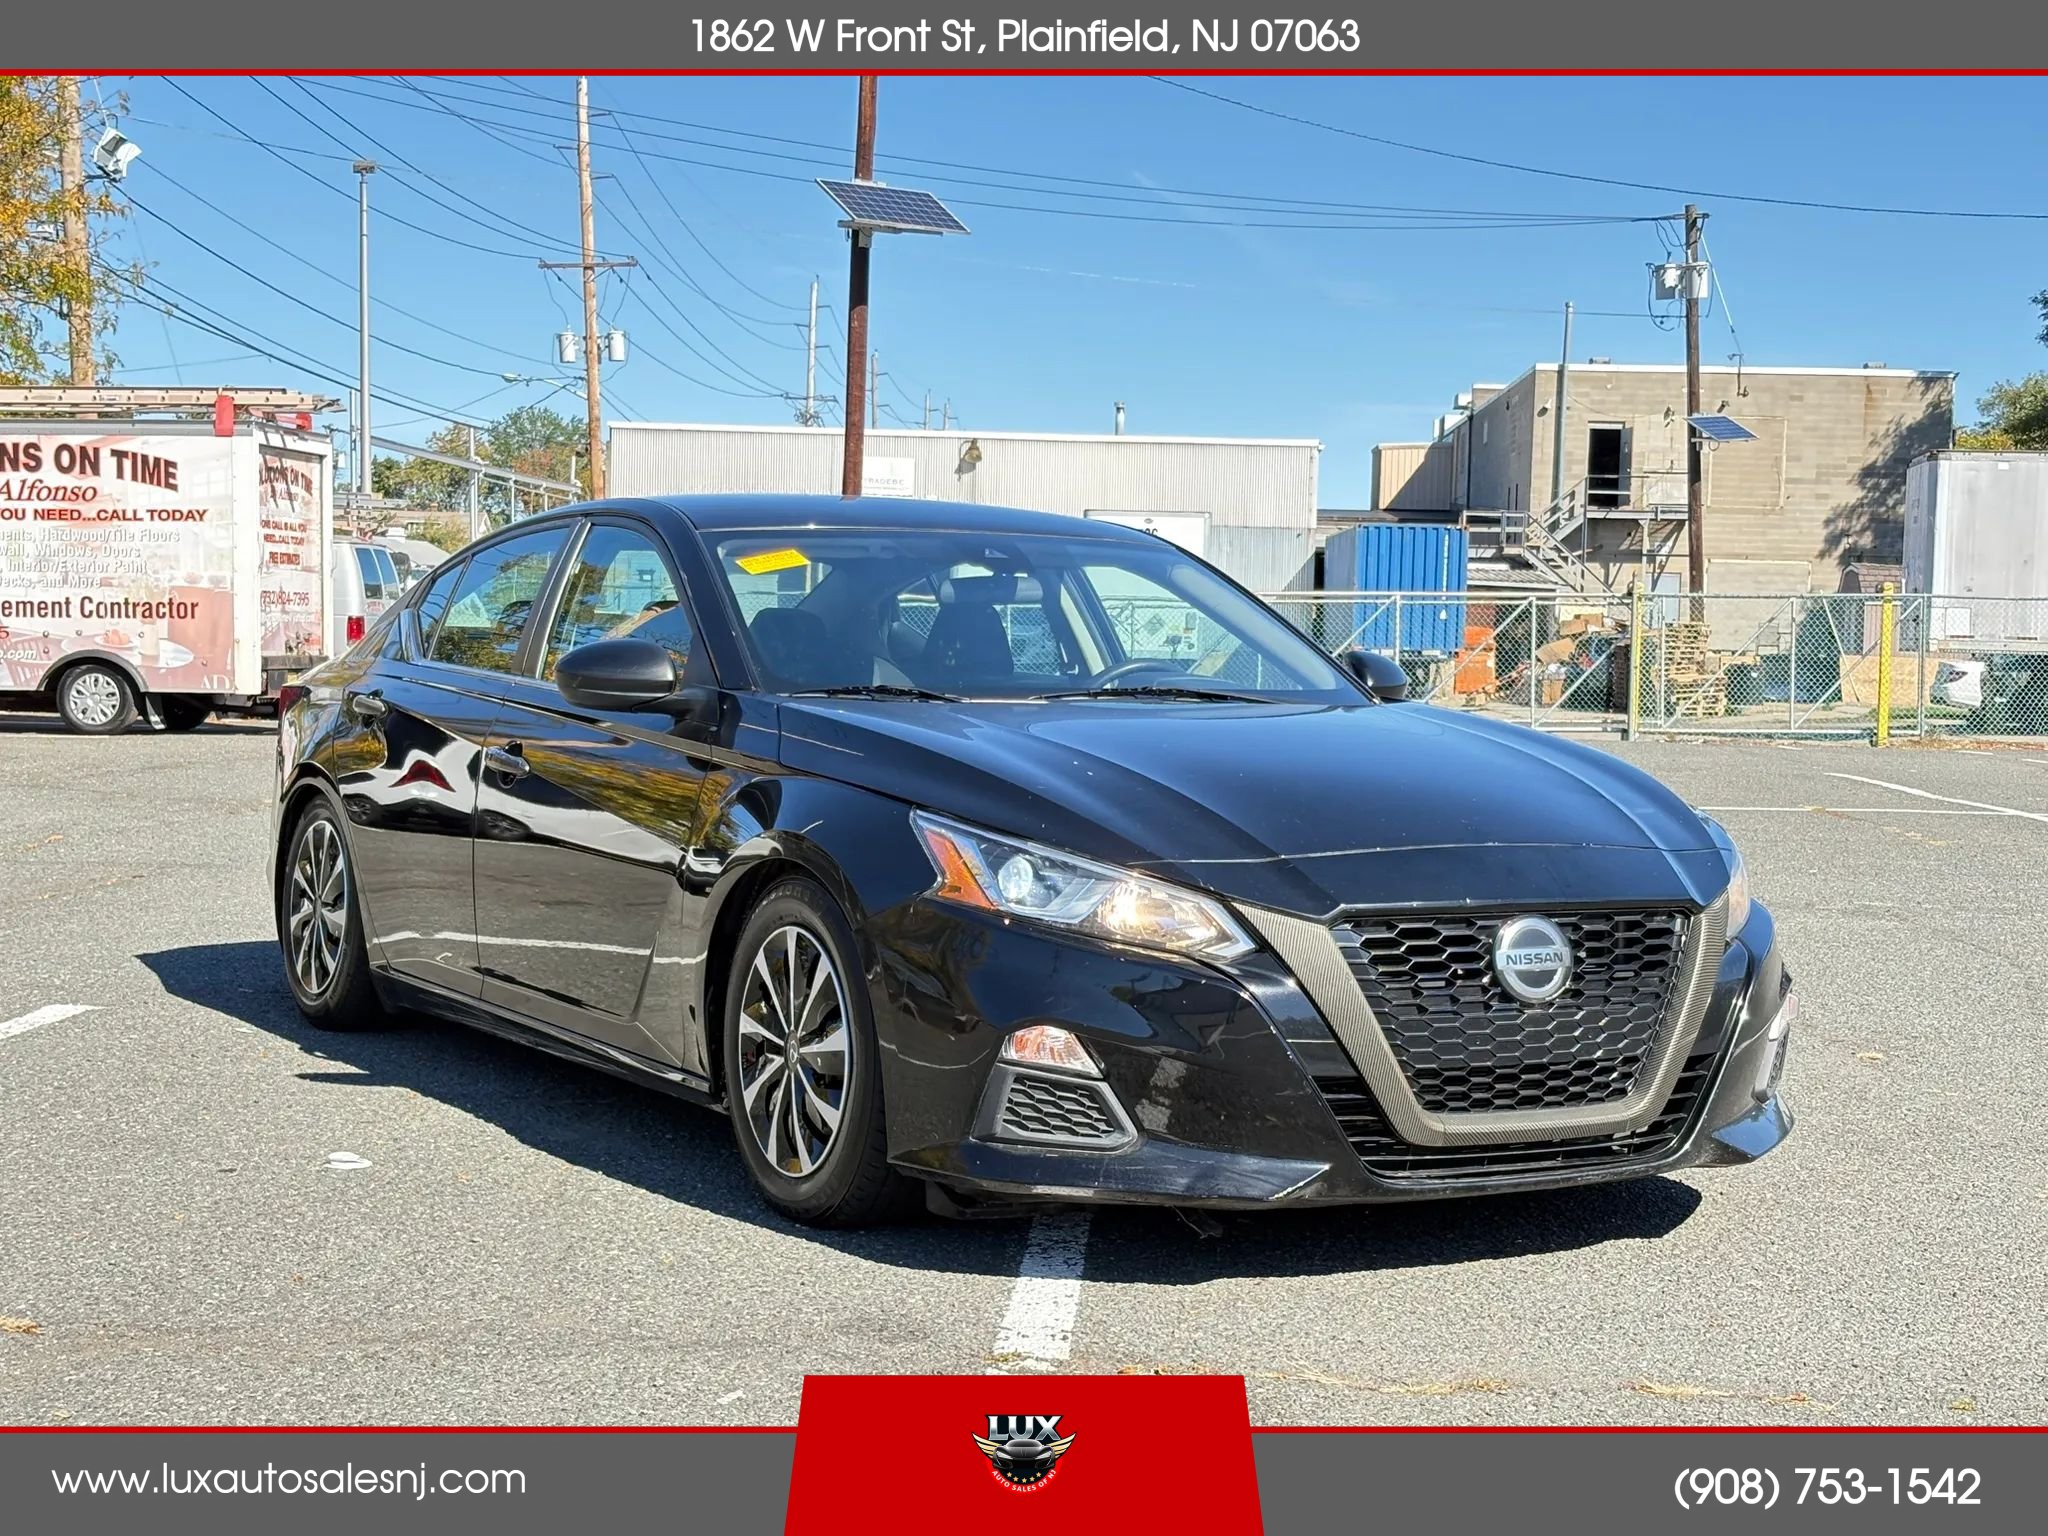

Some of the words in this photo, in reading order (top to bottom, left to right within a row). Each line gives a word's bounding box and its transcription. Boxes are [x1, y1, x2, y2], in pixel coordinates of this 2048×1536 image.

[0, 442, 42, 473] NS
[54, 443, 101, 478] ON
[110, 448, 178, 493] TIME
[0, 478, 98, 502] Alfonso
[33, 507, 144, 522] NEED...CALL
[146, 508, 209, 522] TODAY
[139, 529, 181, 542] Floors
[102, 543, 141, 558] Doors
[0, 576, 36, 590] ecks,
[40, 576, 65, 590] and
[69, 576, 101, 590] More
[1, 597, 72, 618] ement
[80, 596, 199, 620] Contractor
[1505, 951, 1563, 966] NISSAN
